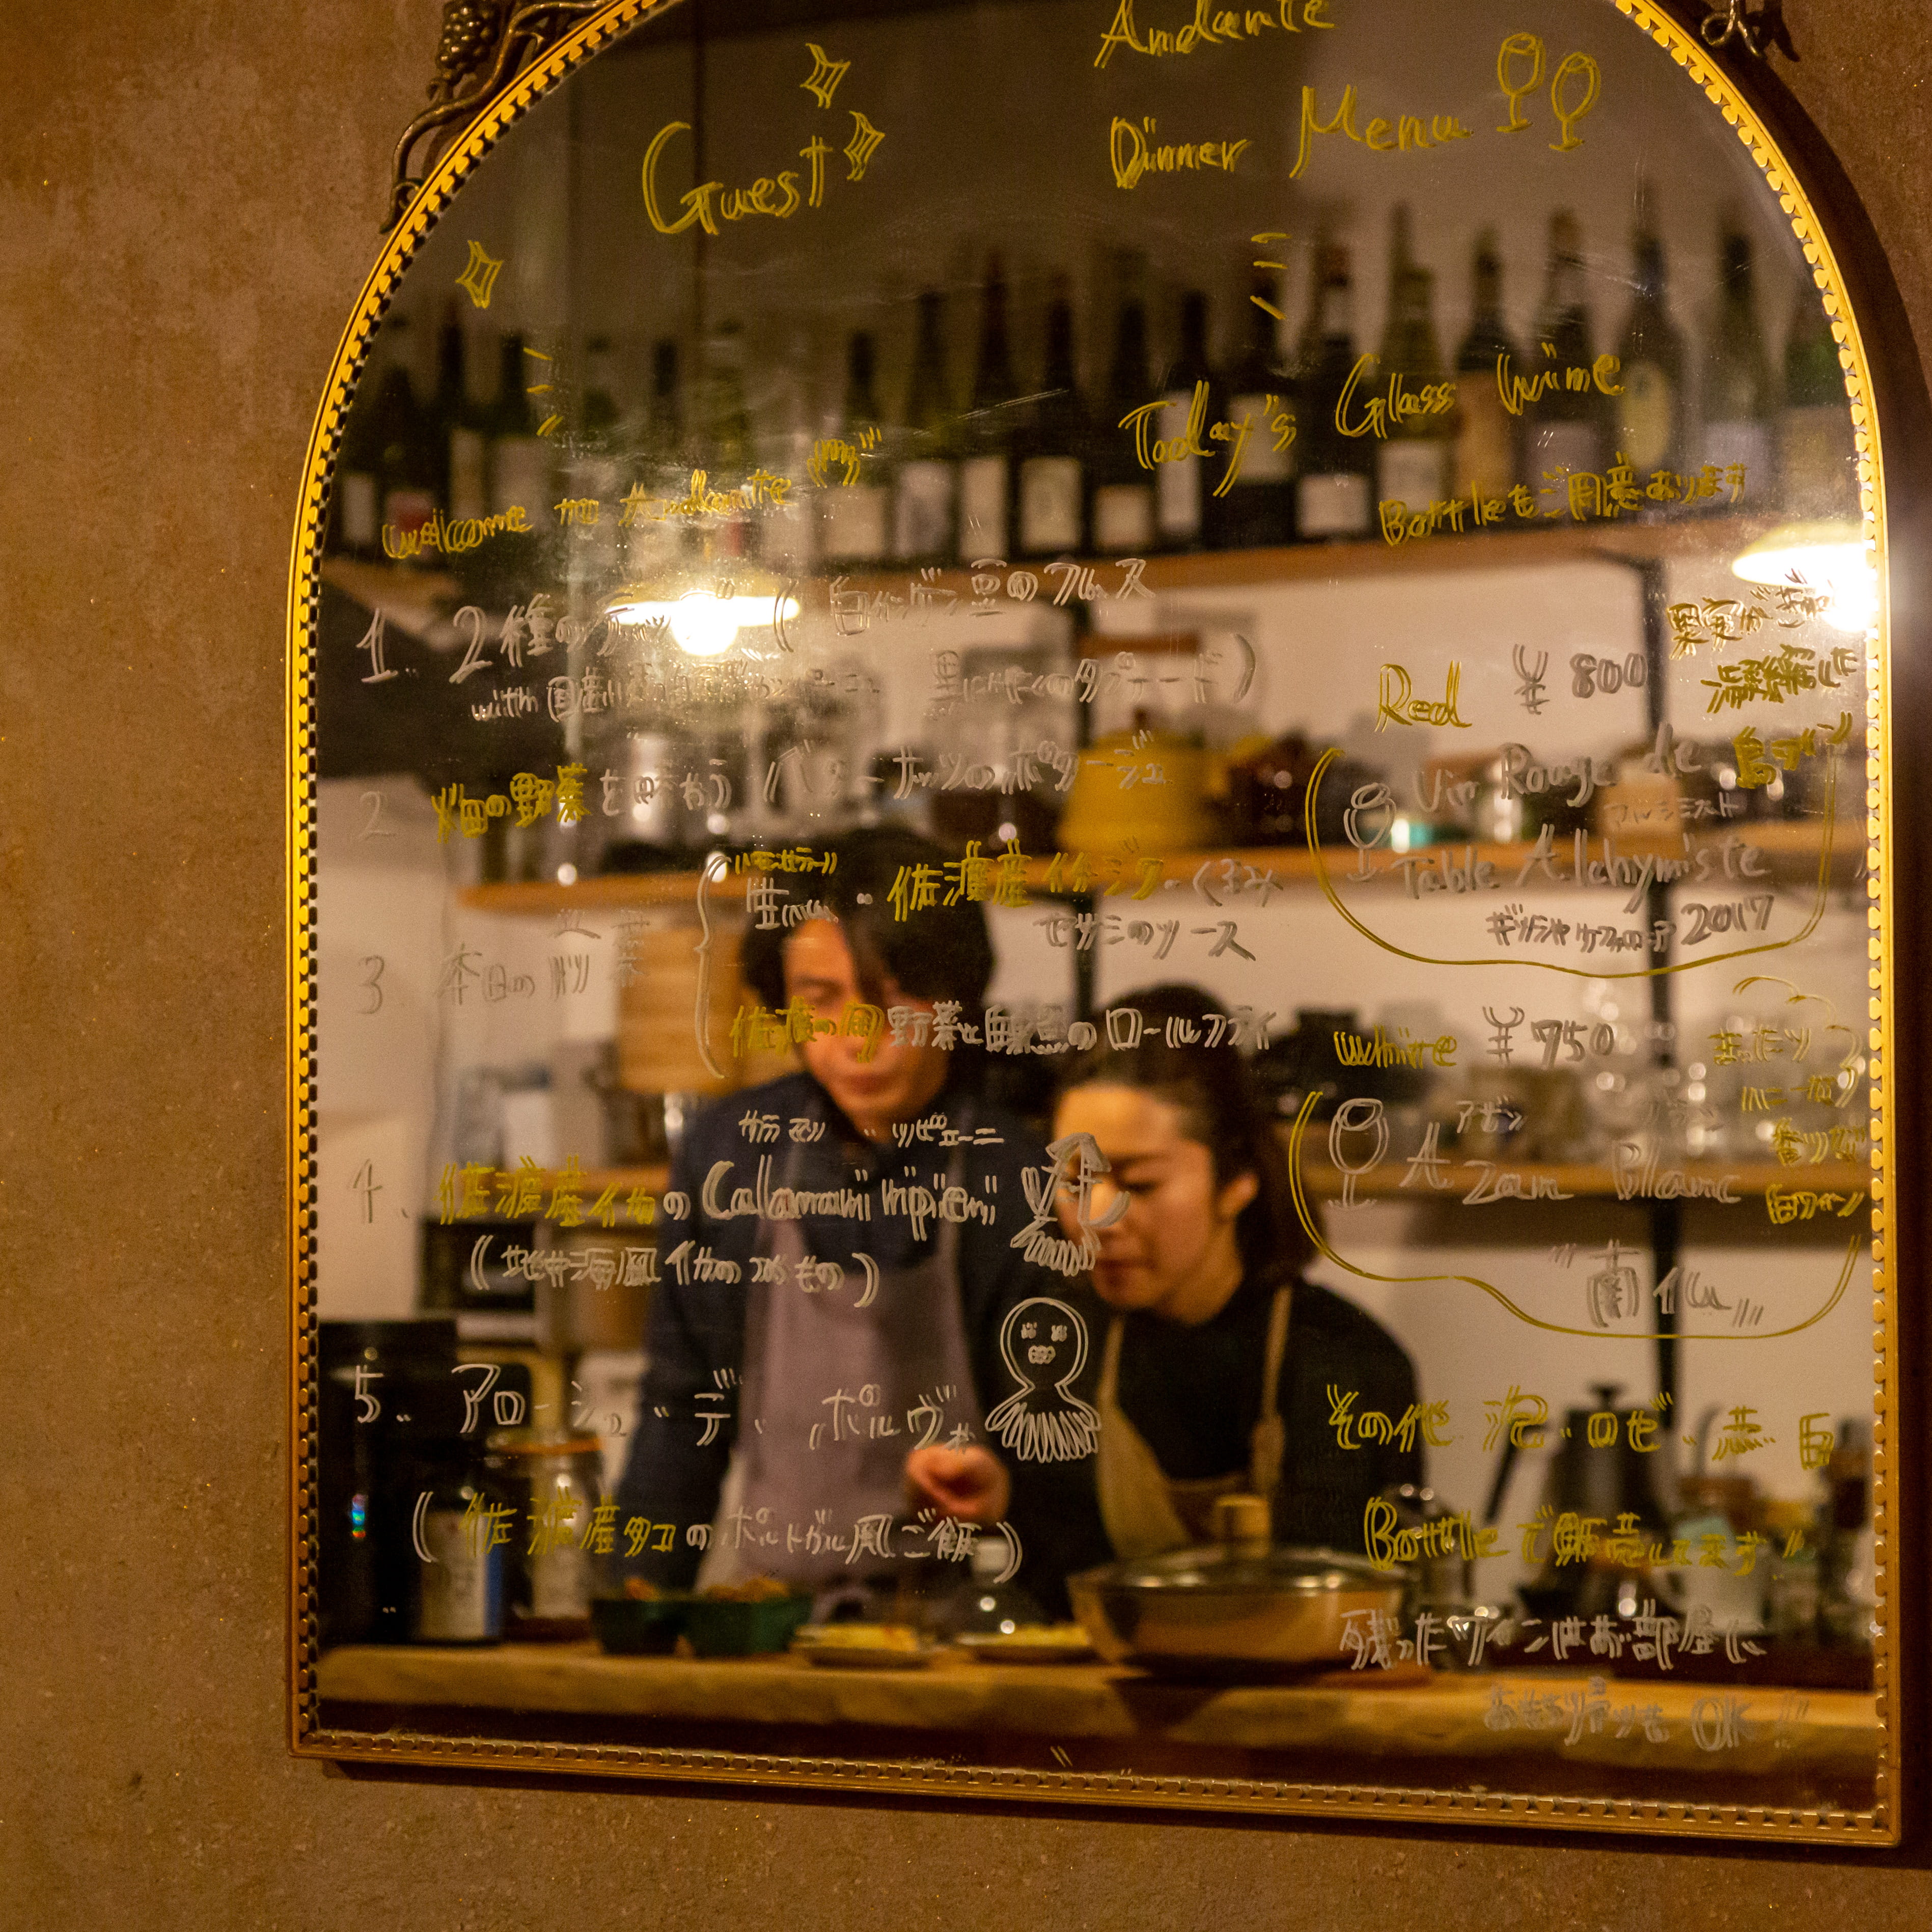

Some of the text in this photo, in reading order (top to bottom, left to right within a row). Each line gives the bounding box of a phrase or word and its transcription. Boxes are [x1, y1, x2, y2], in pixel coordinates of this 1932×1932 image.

[1094, 0, 1334, 68] Andante
[1110, 84, 1473, 189] Dinner Menu
[642, 121, 834, 235] Guest
[1119, 342, 1627, 499] Today's Glass Wine
[472, 687, 540, 722] with
[1375, 660, 1472, 733] Red
[1392, 845, 1500, 899] Table
[1680, 895, 1774, 946] 2017
[1334, 1006, 1615, 1069] White ¥750
